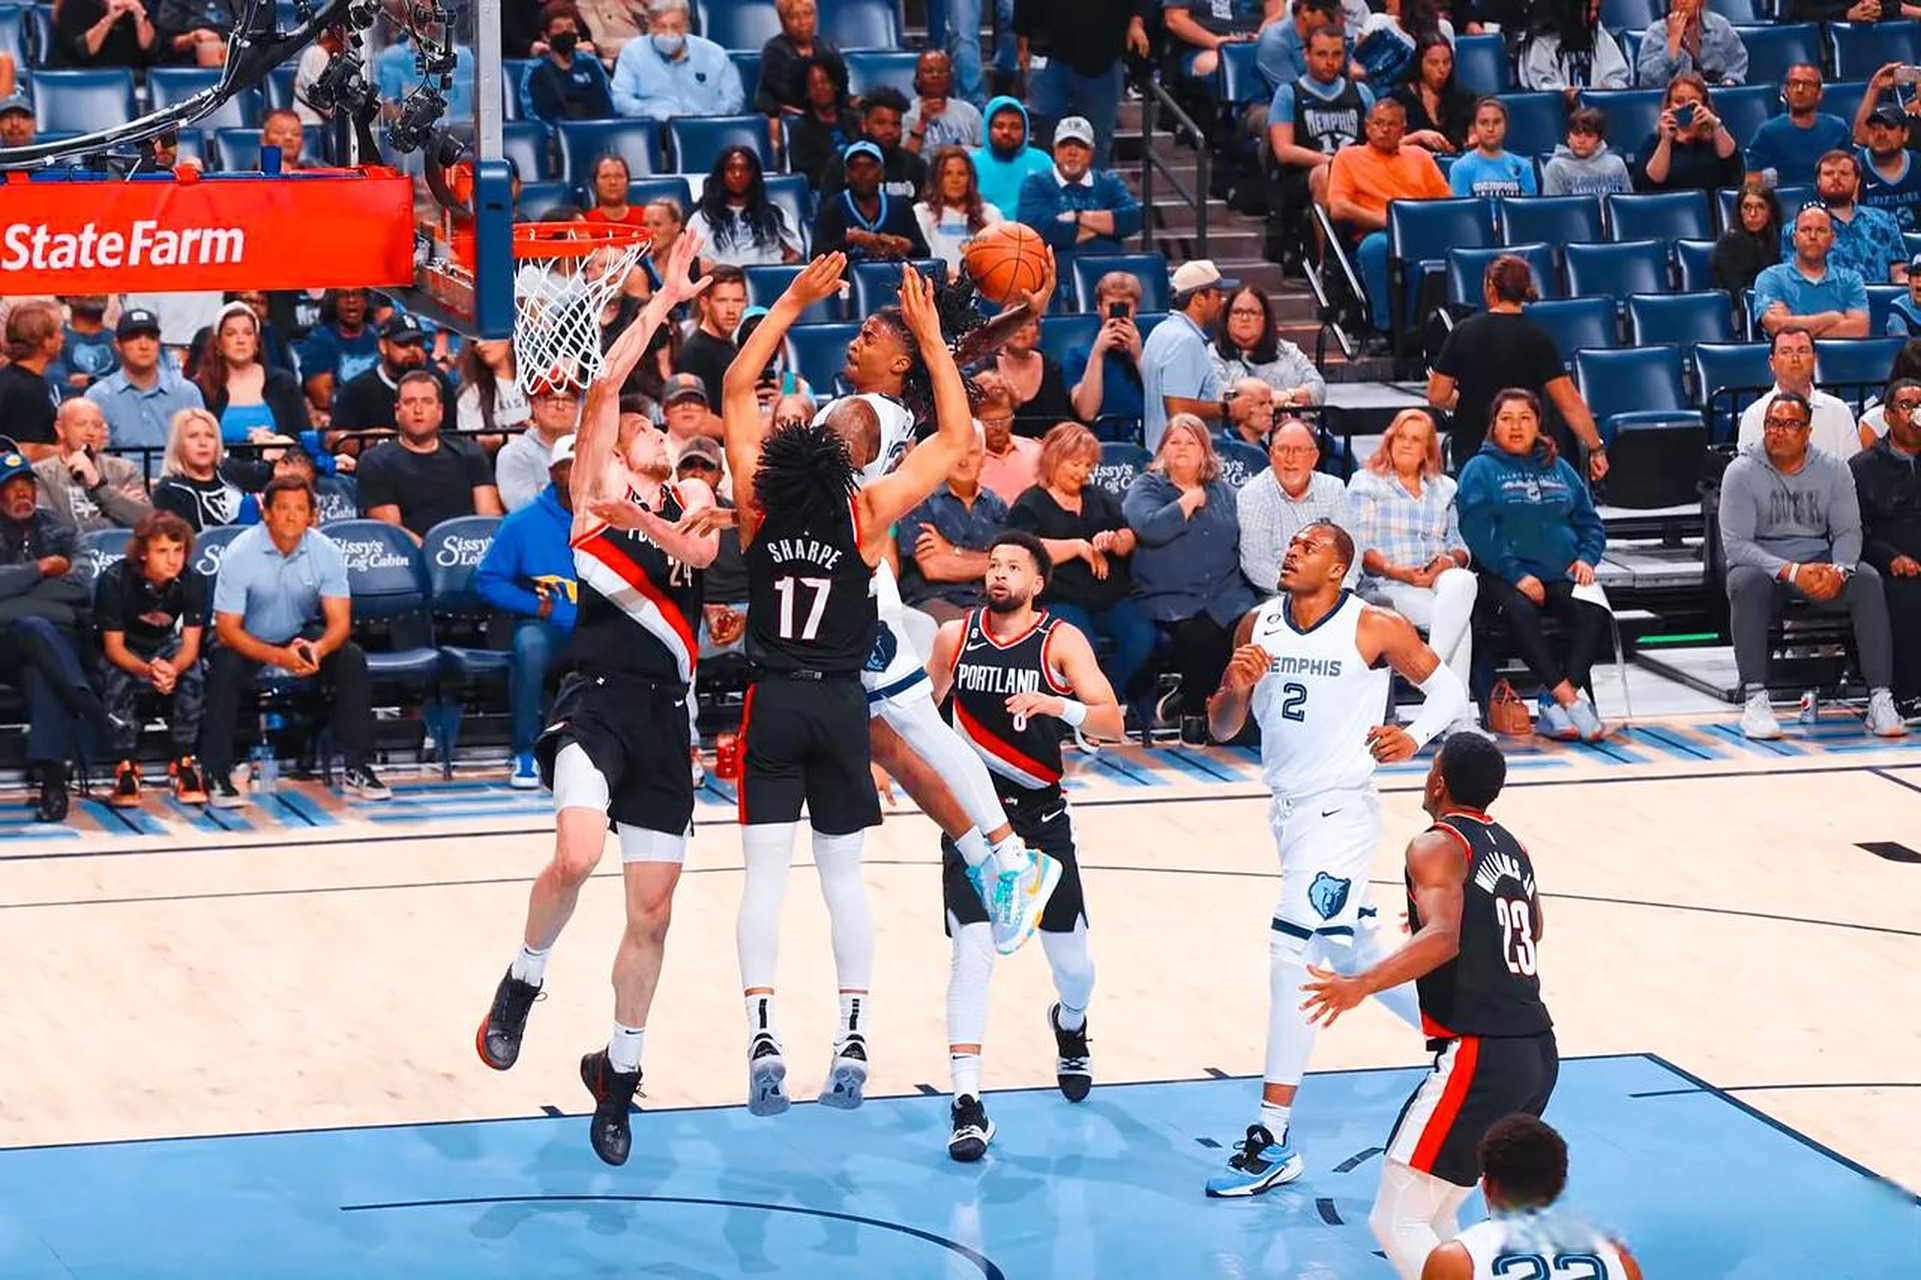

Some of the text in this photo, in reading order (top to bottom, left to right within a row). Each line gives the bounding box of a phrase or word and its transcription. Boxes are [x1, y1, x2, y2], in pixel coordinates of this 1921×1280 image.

[1304, 108, 1358, 138] MEMPHIS
[2, 220, 244, 271] State Farm
[1089, 462, 1134, 485] issy's
[369, 553, 409, 568] Cabin
[768, 539, 842, 571] SHARPE
[774, 575, 832, 640] 17
[958, 663, 1040, 695] PORTLAND
[1269, 656, 1342, 677] EMPHIS
[1281, 682, 1308, 722] 2
[1495, 897, 1536, 976] 23
